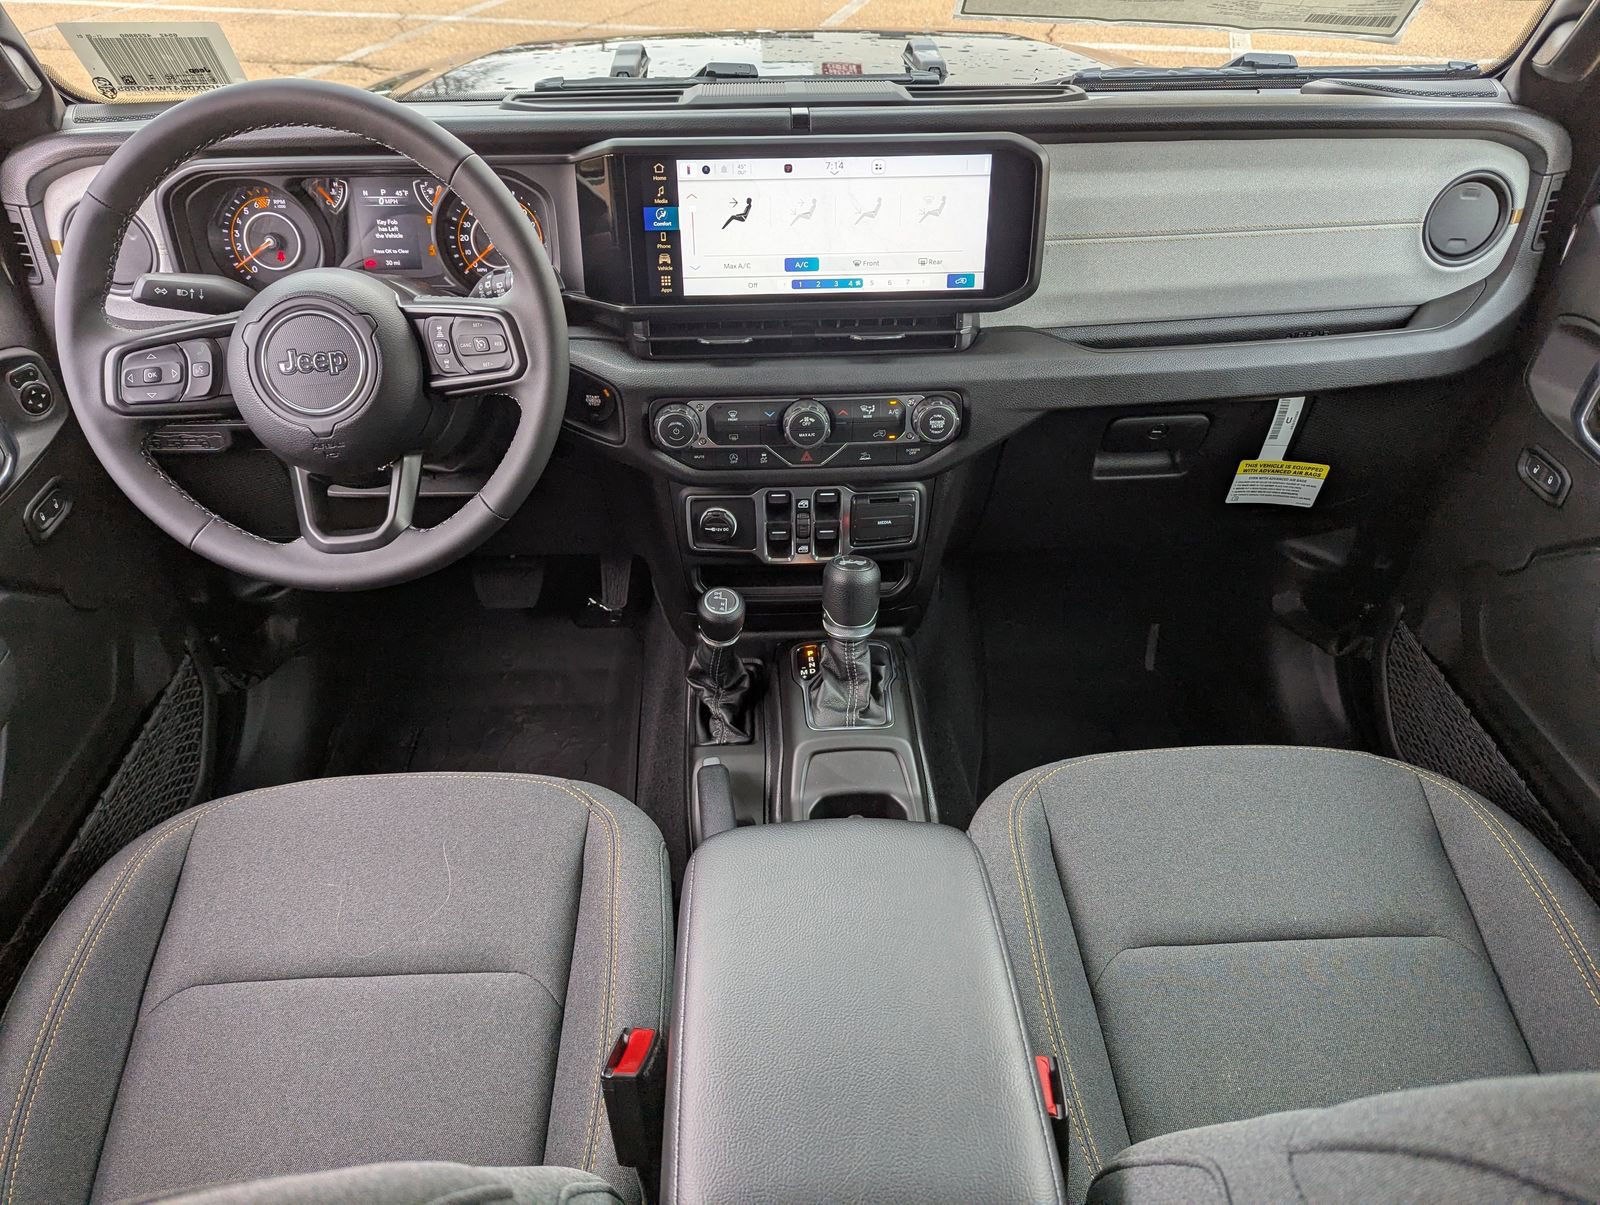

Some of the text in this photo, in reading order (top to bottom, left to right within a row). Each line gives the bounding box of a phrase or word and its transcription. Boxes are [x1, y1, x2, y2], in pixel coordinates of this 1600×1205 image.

[825, 161, 844, 169] 7:14
[234, 230, 240, 238] 3
[236, 243, 242, 251] 2
[278, 349, 348, 376] Jeep
